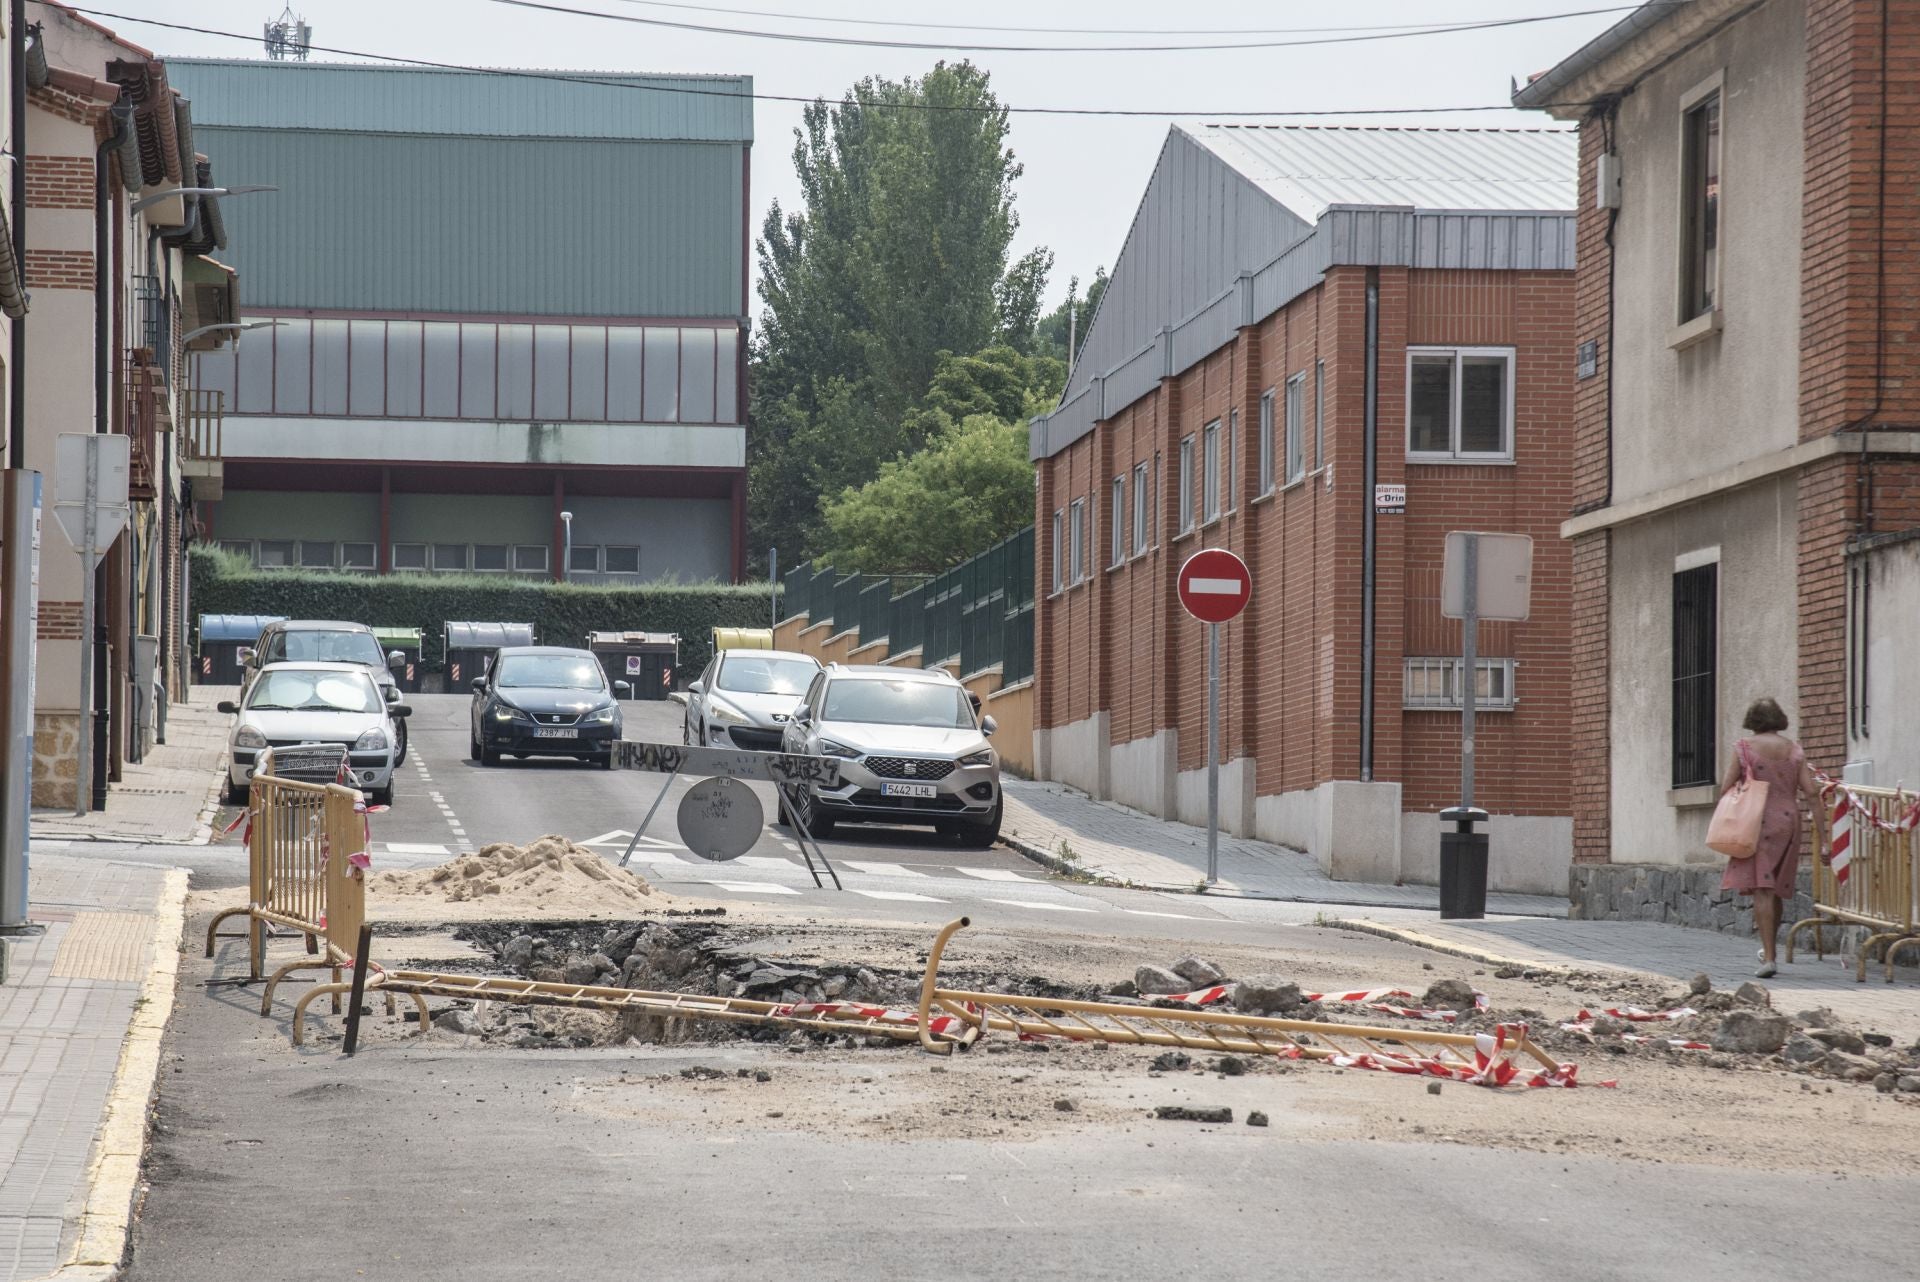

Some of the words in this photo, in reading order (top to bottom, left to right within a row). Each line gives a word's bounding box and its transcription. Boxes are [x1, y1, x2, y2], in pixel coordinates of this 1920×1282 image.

[1376, 485, 1405, 493] alarma
[1384, 494, 1405, 502] Drin
[539, 729, 559, 737] 2387
[888, 784, 911, 795] 5442
[915, 786, 933, 797] LHL
